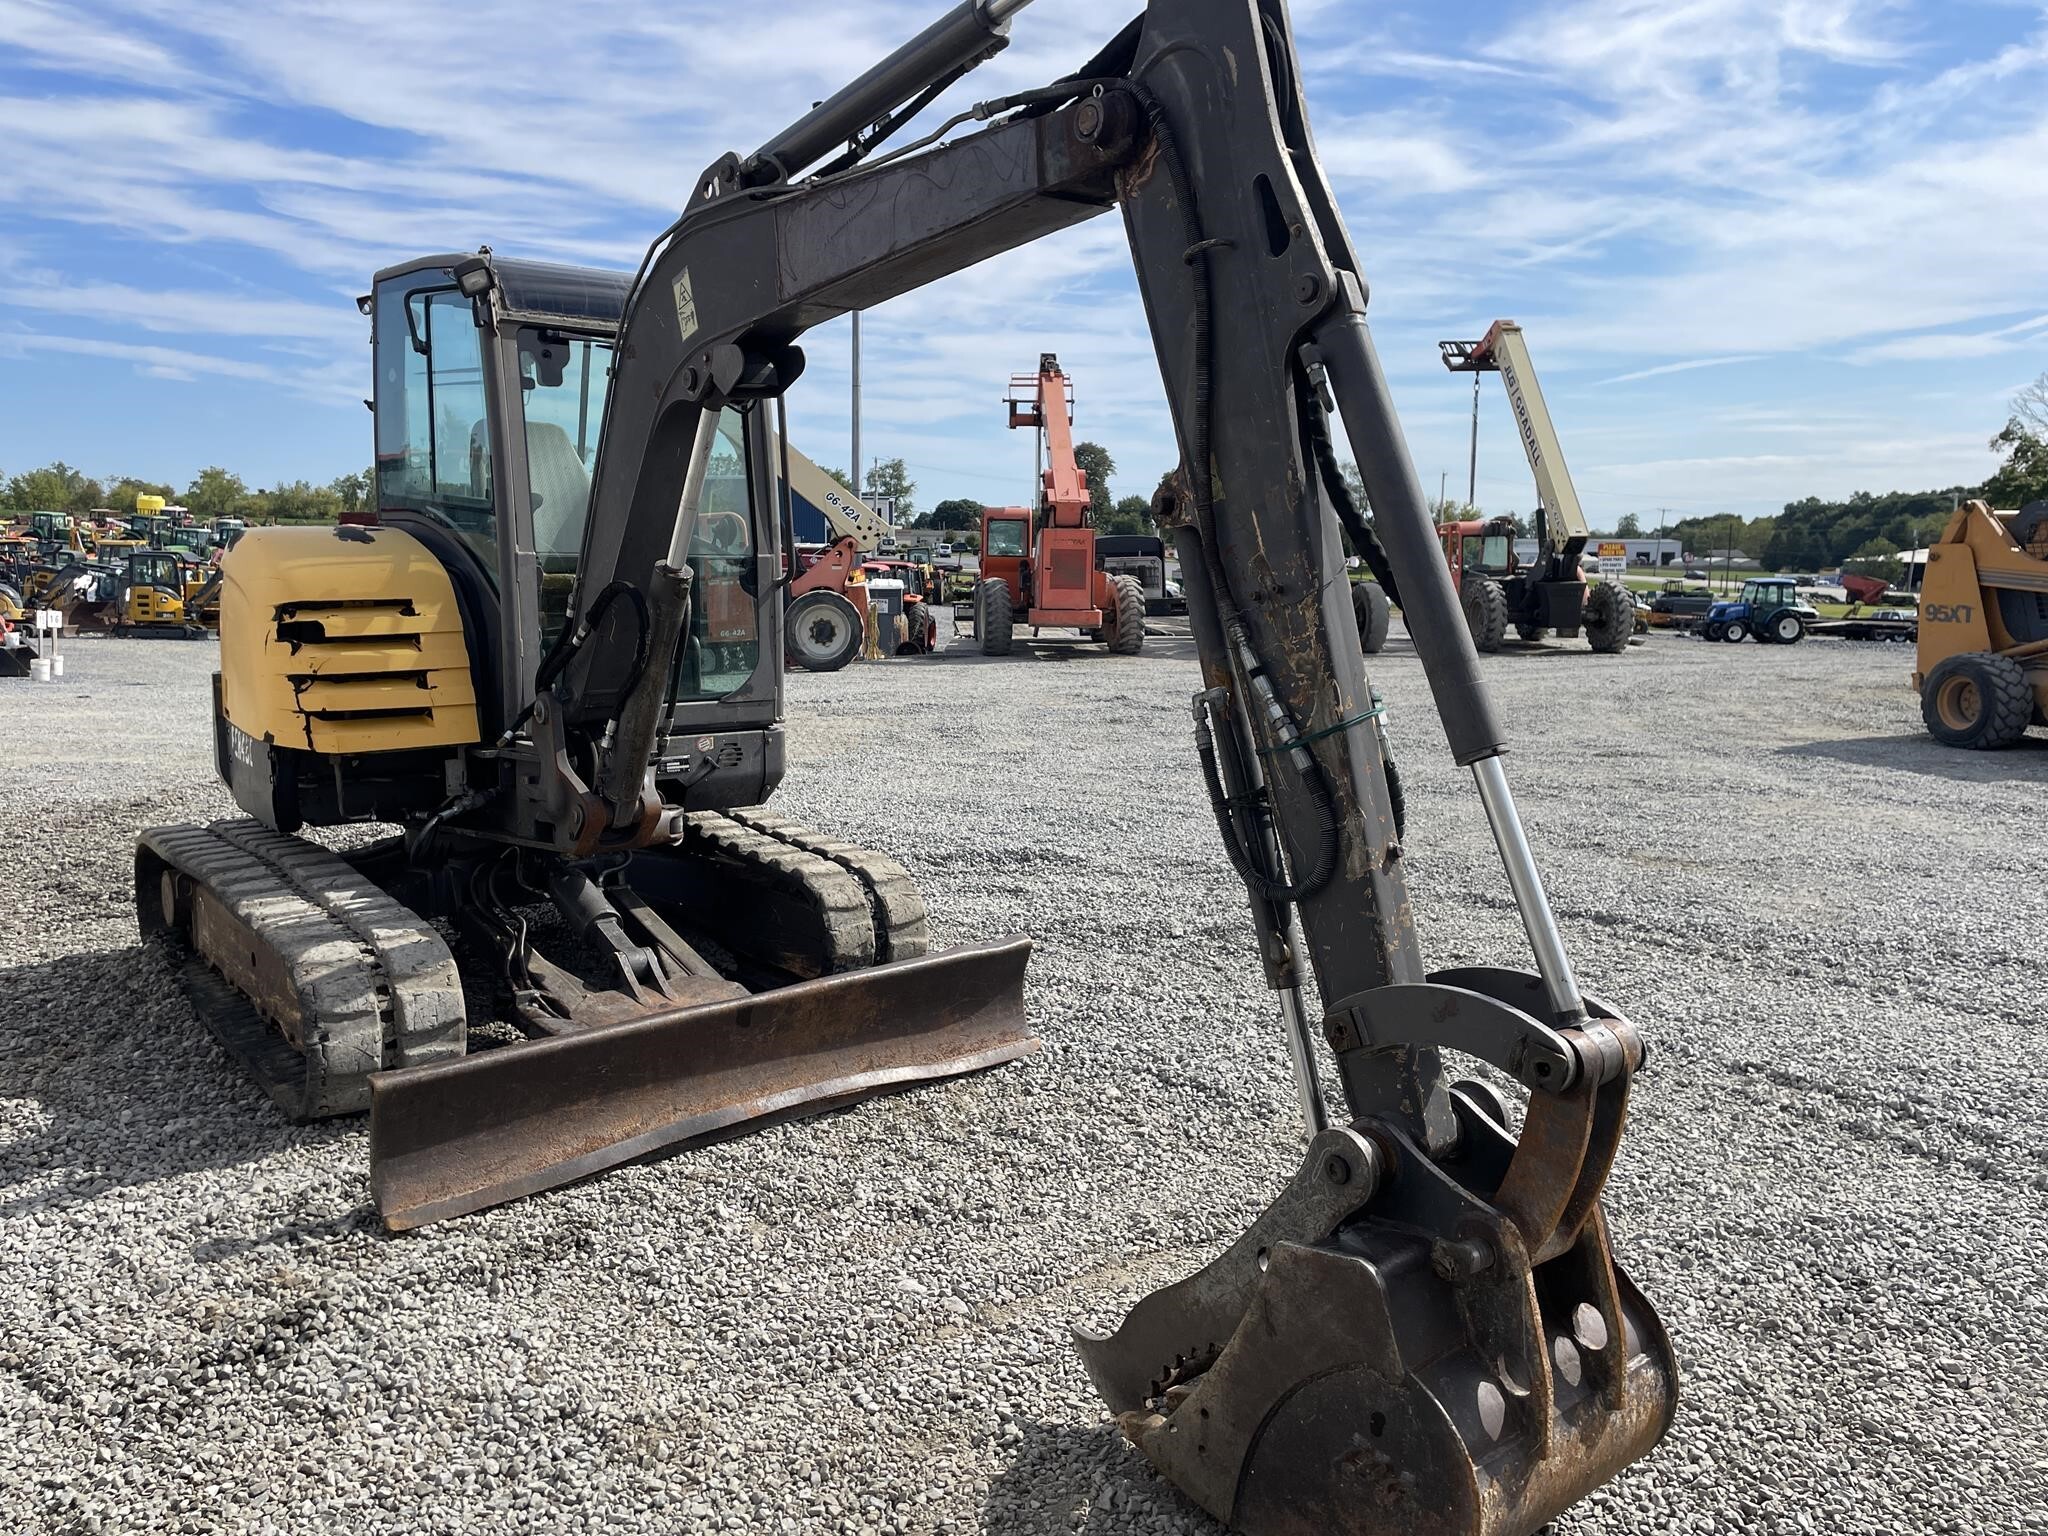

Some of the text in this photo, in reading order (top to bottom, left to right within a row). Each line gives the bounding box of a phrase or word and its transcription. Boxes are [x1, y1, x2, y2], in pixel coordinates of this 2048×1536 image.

[1516, 397, 1541, 467] GRADALL
[826, 492, 861, 523] G6-42A
[1925, 604, 1974, 624] 95XT
